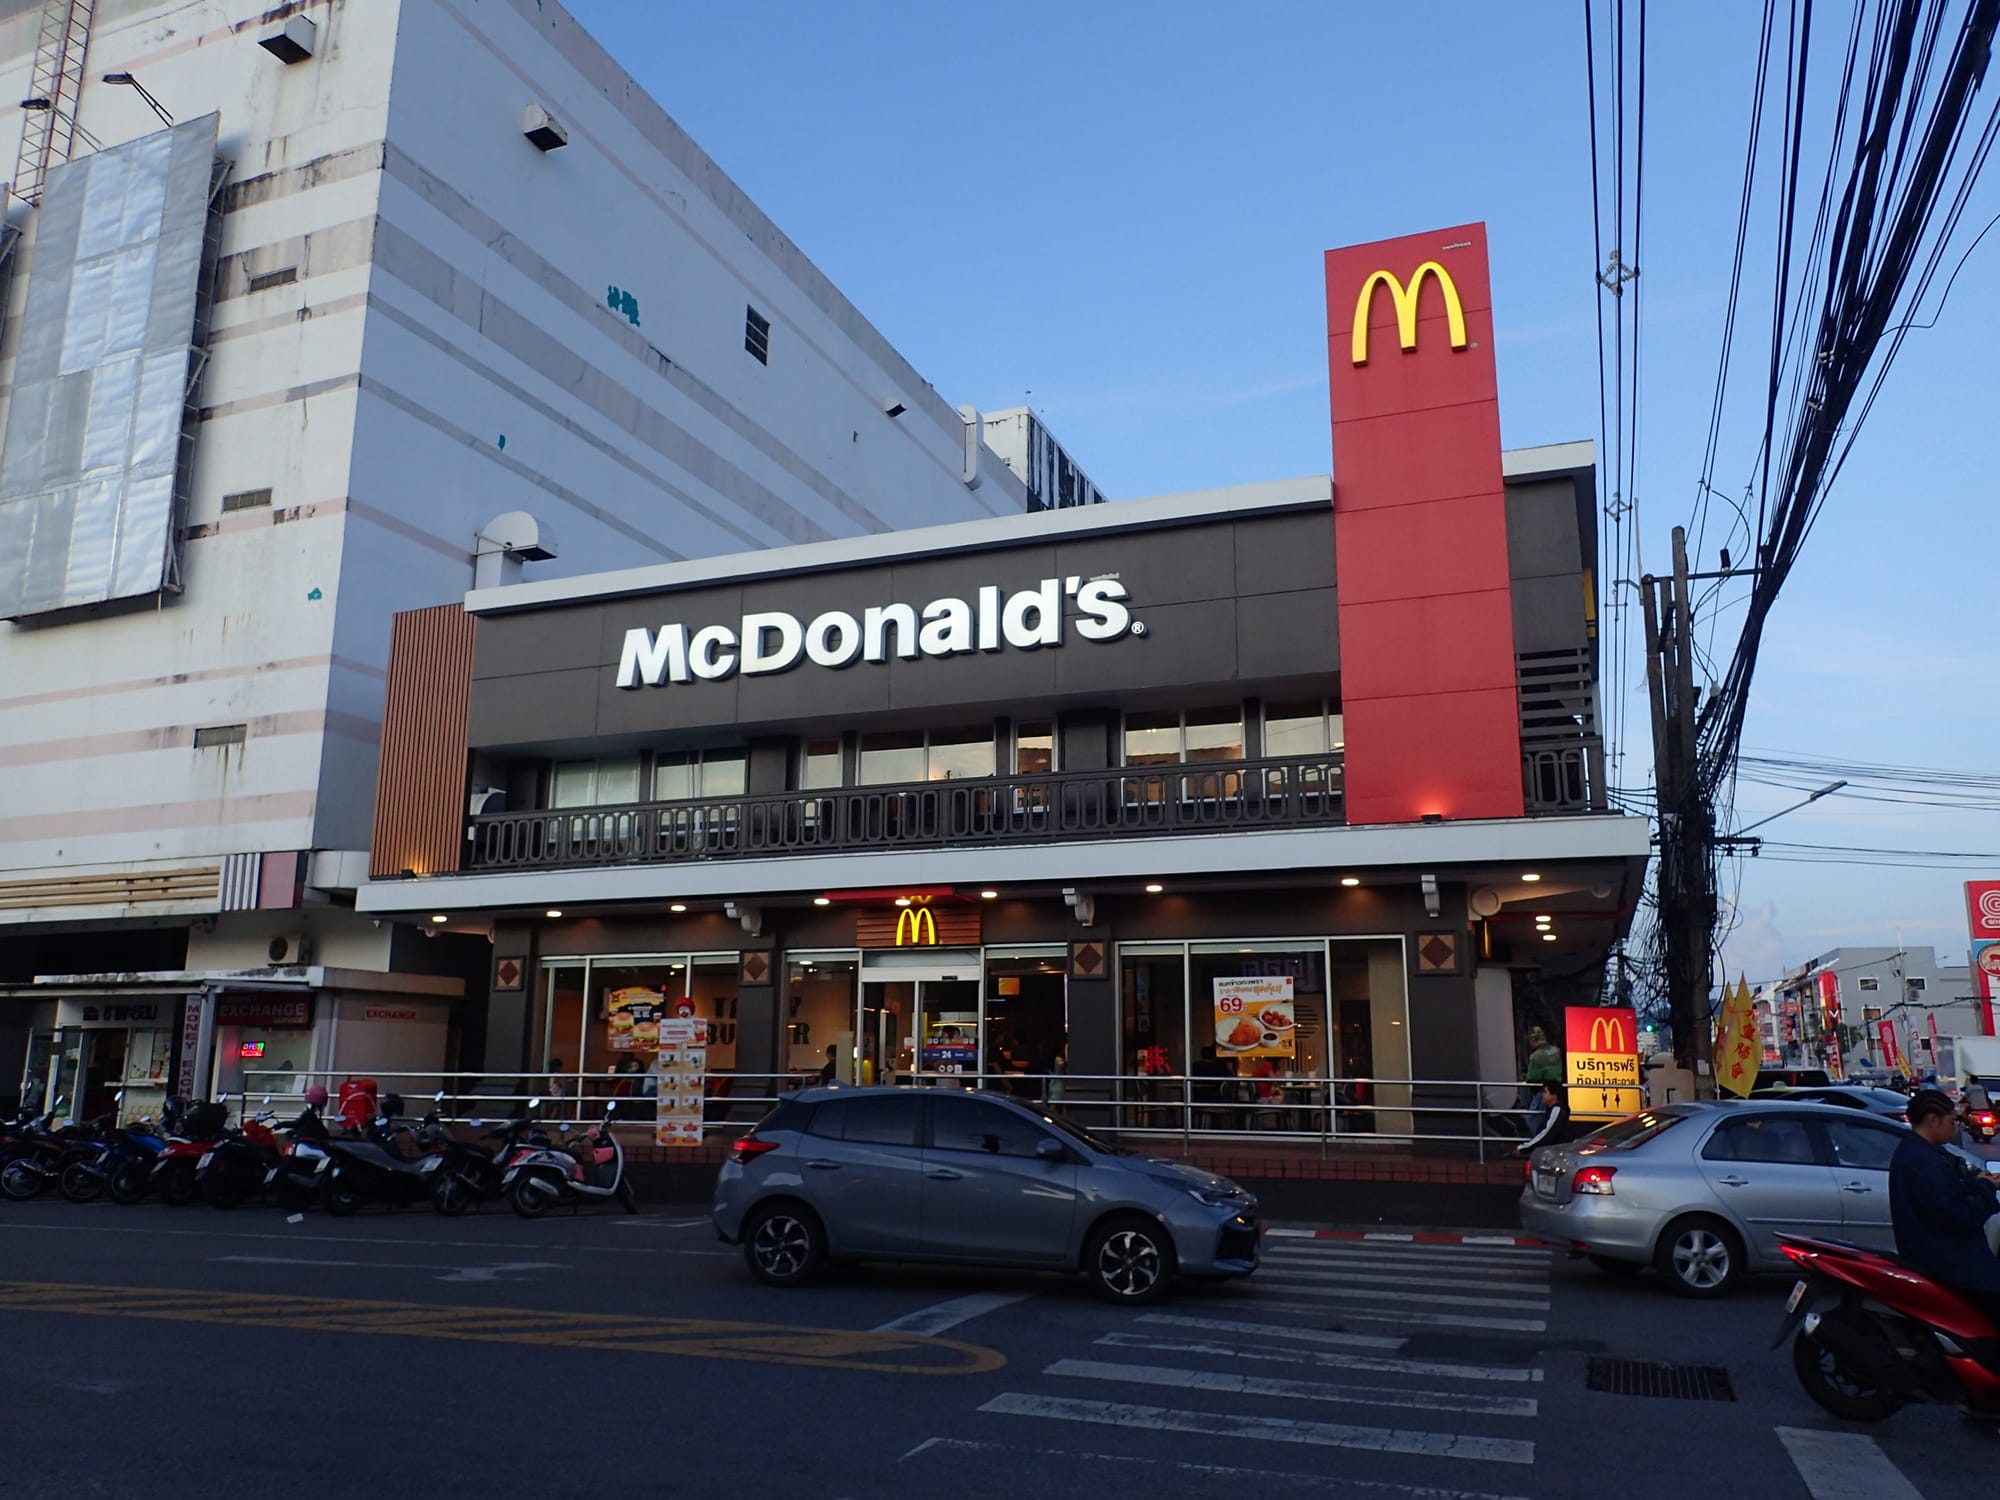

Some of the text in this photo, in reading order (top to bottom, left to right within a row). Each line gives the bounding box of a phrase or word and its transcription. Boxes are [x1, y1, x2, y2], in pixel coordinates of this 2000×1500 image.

[616, 576, 1130, 688] McDonald's
[219, 1003, 305, 1017] EXCHANGE
[1220, 997, 1242, 1012] 69
[366, 1009, 417, 1019] EXCHANGE
[185, 1005, 200, 1049] MONEY
[941, 1050, 952, 1059] 24
[1576, 1058, 1635, 1072] บริการฟรี
